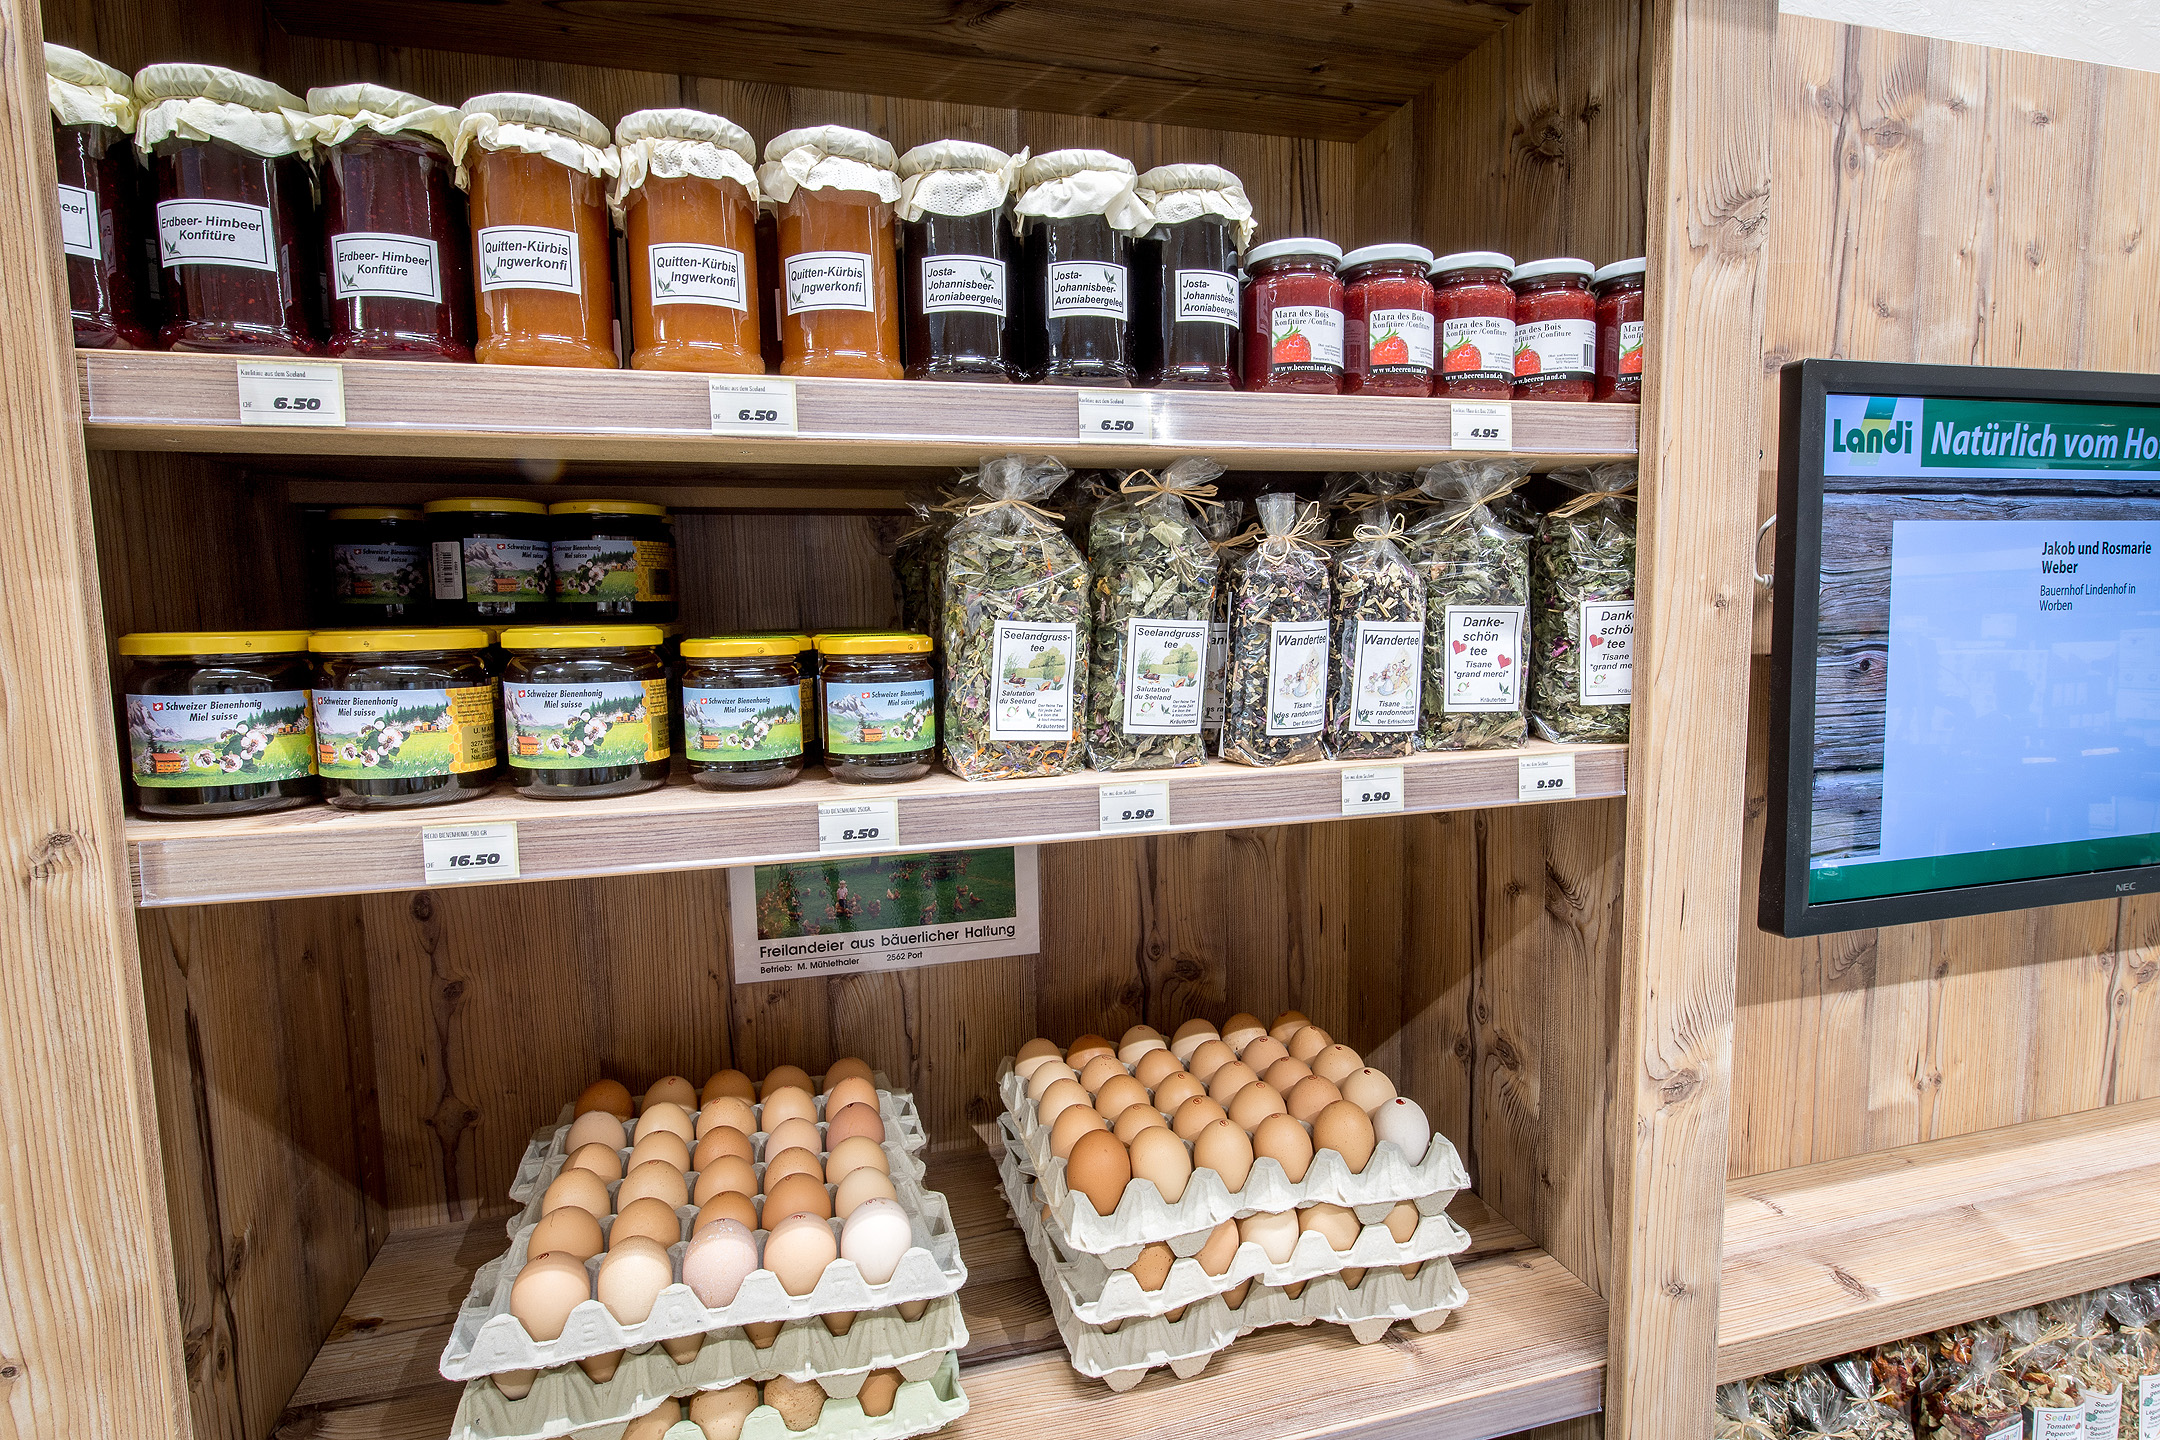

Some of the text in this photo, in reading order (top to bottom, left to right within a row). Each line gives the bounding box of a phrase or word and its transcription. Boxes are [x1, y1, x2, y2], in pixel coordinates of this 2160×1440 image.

[161, 215, 262, 232] Erdbeer- Himbeer
[179, 229, 236, 242] Konfitüre
[484, 240, 569, 257] Quitten-Kürbis
[339, 250, 430, 267] Erdbeer- Himbeer
[496, 255, 568, 272] Ingwerkonfi
[357, 263, 408, 277] Konfitüre
[656, 256, 737, 274] Quitten-Kürbis
[791, 266, 863, 282] Quitten-Kürbis
[927, 267, 956, 278] Josta-
[1054, 270, 1082, 281] Josta-
[670, 270, 737, 288] Ingwerkonfi
[1183, 279, 1210, 289] Josta-
[801, 281, 862, 295] Ingwerkonfi
[928, 279, 995, 291] Johannisbeer-
[1055, 283, 1116, 294] Johannisbeer-
[928, 291, 1002, 307] Aroniabeergelee
[1055, 295, 1123, 309] Aroniabeergelee
[1183, 291, 1235, 305] Johannisbeer-
[1275, 309, 1330, 319] Mara des Bois
[1372, 312, 1425, 322] Mara des Bois
[1274, 318, 1307, 327] Konfitüre
[1372, 321, 1404, 330] Konfitüre
[1446, 320, 1501, 331] Mara des Bois
[1446, 328, 1477, 338] Konfitüre
[1528, 323, 1562, 334] des Bois
[1274, 364, 1333, 373] www.beerenland.ch
[1373, 366, 1428, 375] www.beerenland.ch
[1445, 371, 1503, 381] www.beerenland.ch
[273, 397, 321, 410] 6.50
[738, 409, 778, 421] 6.50
[1101, 420, 1134, 431] 6.50
[1470, 428, 1499, 438] 4.95
[1832, 418, 1913, 455] Landi
[1931, 421, 2057, 457] Natürlich
[2065, 432, 2117, 459] vom
[507, 543, 531, 551] Schweizer
[2042, 541, 2152, 556] Jakob und Rosmarie
[2042, 560, 2078, 574] Weber
[2040, 583, 2136, 597] Bauernhof Lindenhof in
[2039, 600, 2073, 611] Worben
[1463, 616, 1504, 627] Danke-
[1003, 630, 1070, 643] Seelandgruss-
[1137, 627, 1203, 639] Seelandgruss-
[1463, 632, 1499, 642] schön
[1164, 640, 1178, 649] tee
[1278, 634, 1326, 646] Wandertee
[1364, 634, 1419, 646] Wandertee
[1607, 640, 1626, 648] tee
[1030, 644, 1045, 652] tee
[1470, 647, 1487, 656] tee
[1602, 653, 1629, 661] Tisane
[1466, 660, 1492, 668] Tisane
[527, 689, 603, 699] Schweizer Bienenhonig
[871, 689, 925, 699] Schweizer Bienenhonig
[1136, 685, 1170, 693] Salutation
[165, 700, 262, 711] Schweizer Bienenhonig
[323, 697, 399, 707] Schweizer Bienenhonig
[543, 700, 582, 709] Miel suisse
[708, 696, 770, 706] Schweizer Bienenhonig
[887, 698, 915, 706] Miel suisse
[337, 708, 376, 717] Miel suisse
[723, 705, 737, 714] Miel
[1291, 709, 1323, 718] randonneurs
[189, 712, 238, 722] Miel suisse
[1537, 779, 1564, 788] 9.90
[1361, 791, 1391, 802] 9.90
[1121, 809, 1154, 820] 9.90
[842, 827, 879, 840] 8.50
[449, 853, 501, 867] 16.50
[2115, 882, 2136, 892] NEC
[759, 923, 1016, 959] Freilandeier aus bäuerlicher Haltung
[760, 950, 923, 974] Betrieb: M. Mühlethaler 2562 Port
[2044, 1411, 2081, 1421] Seeland
[2046, 1422, 2076, 1430] Tomaten
